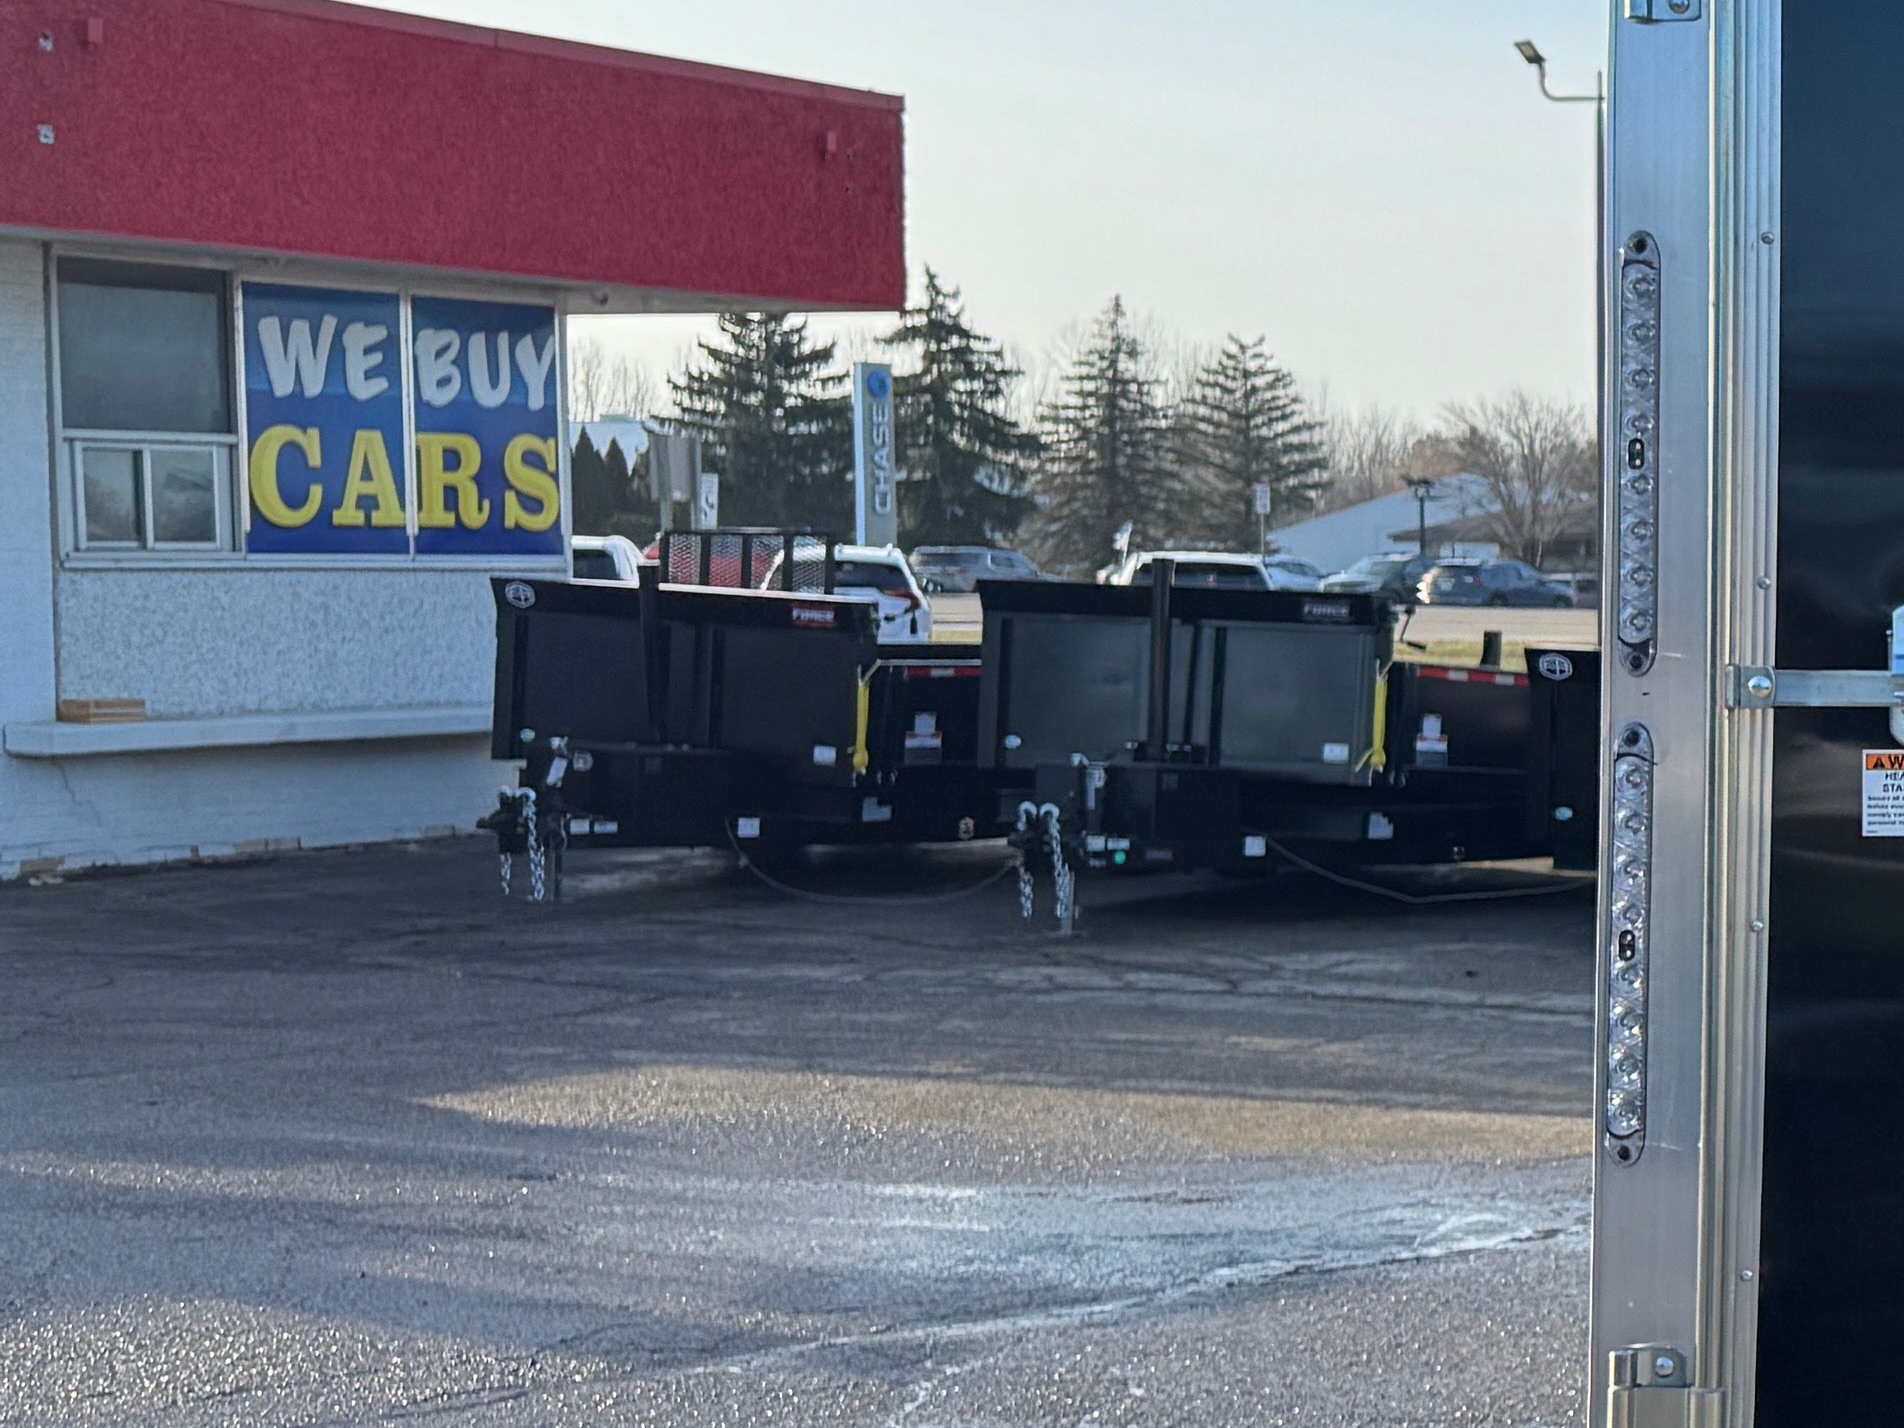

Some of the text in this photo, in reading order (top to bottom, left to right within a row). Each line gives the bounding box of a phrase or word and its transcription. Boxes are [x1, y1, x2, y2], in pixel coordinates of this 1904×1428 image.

[257, 314, 557, 412] WE BUY
[249, 423, 561, 533] CARS
[872, 401, 892, 516] CHASE
